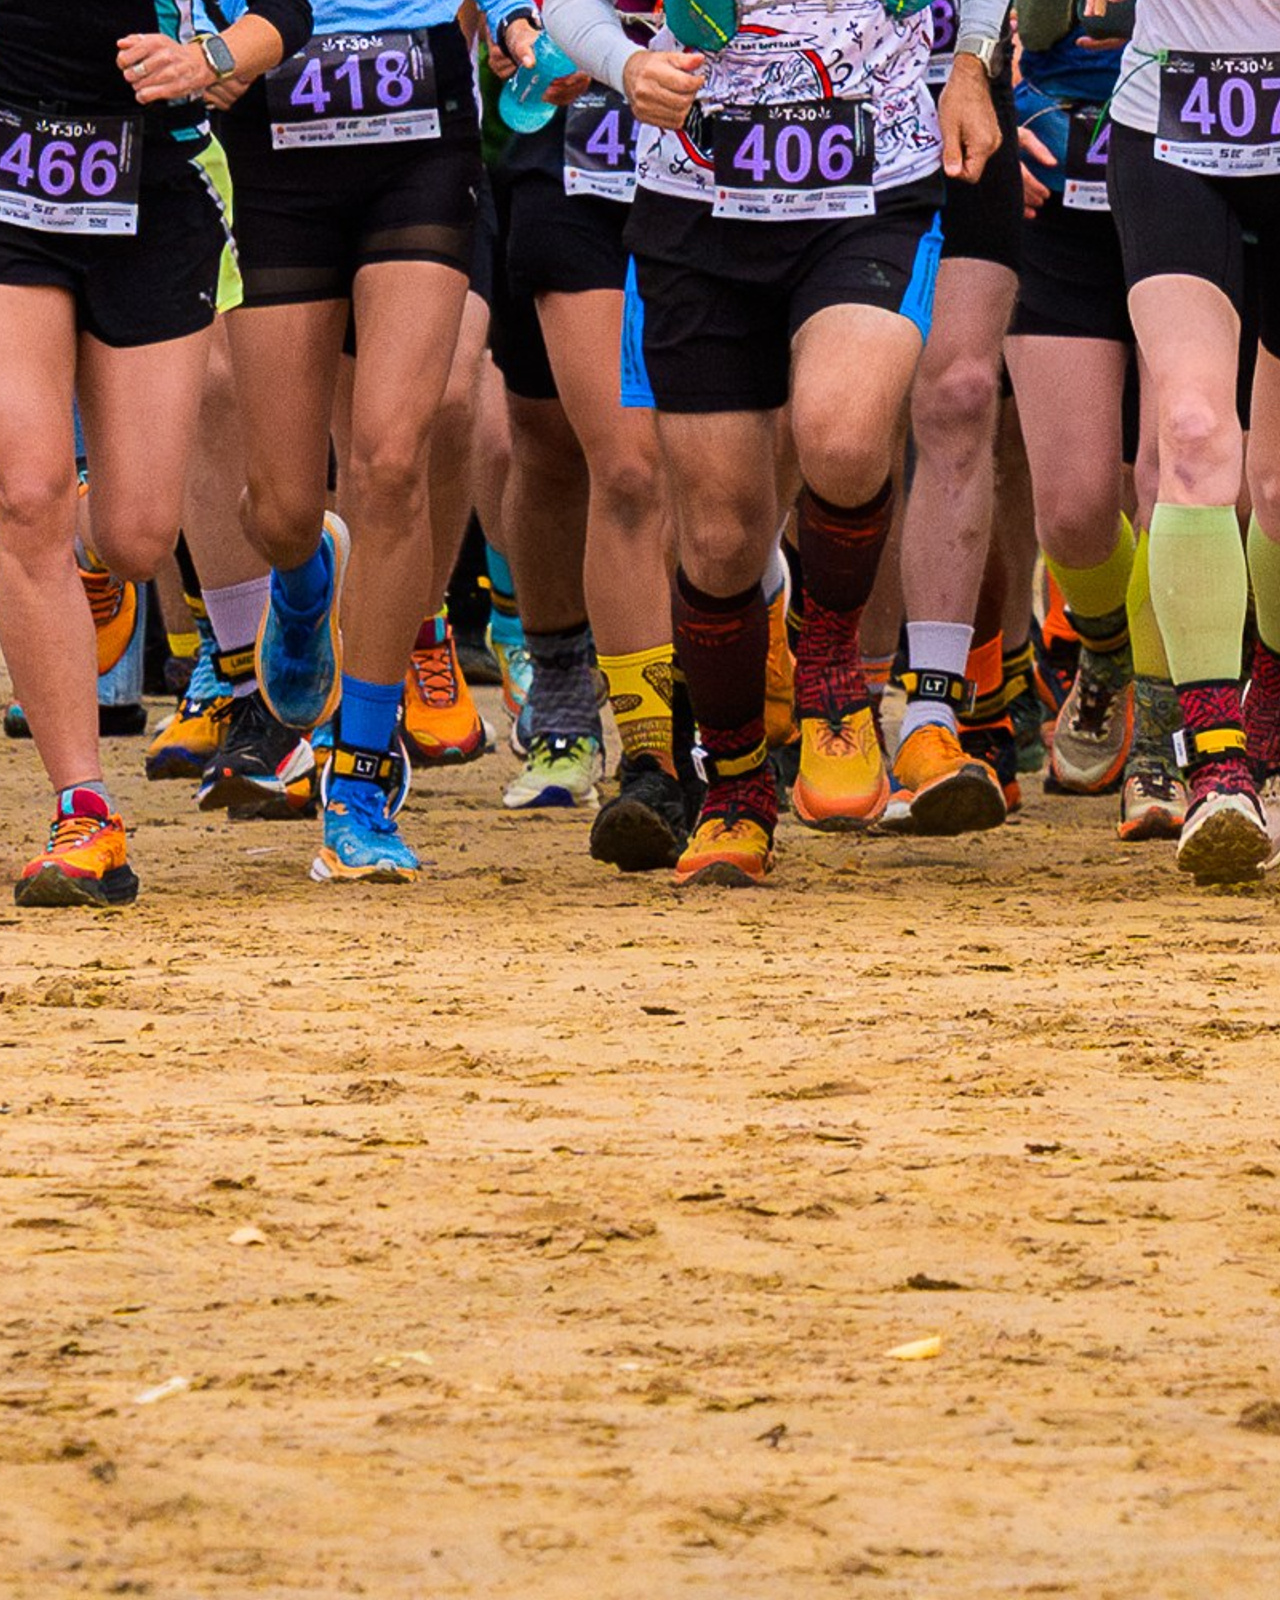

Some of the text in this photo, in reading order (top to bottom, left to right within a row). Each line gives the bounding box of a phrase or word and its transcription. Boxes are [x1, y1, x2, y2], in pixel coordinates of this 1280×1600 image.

[290, 50, 414, 113] 418
[0, 131, 118, 197] 466
[733, 123, 854, 184] 406
[924, 679, 943, 692] LT
[356, 759, 373, 773] LT
